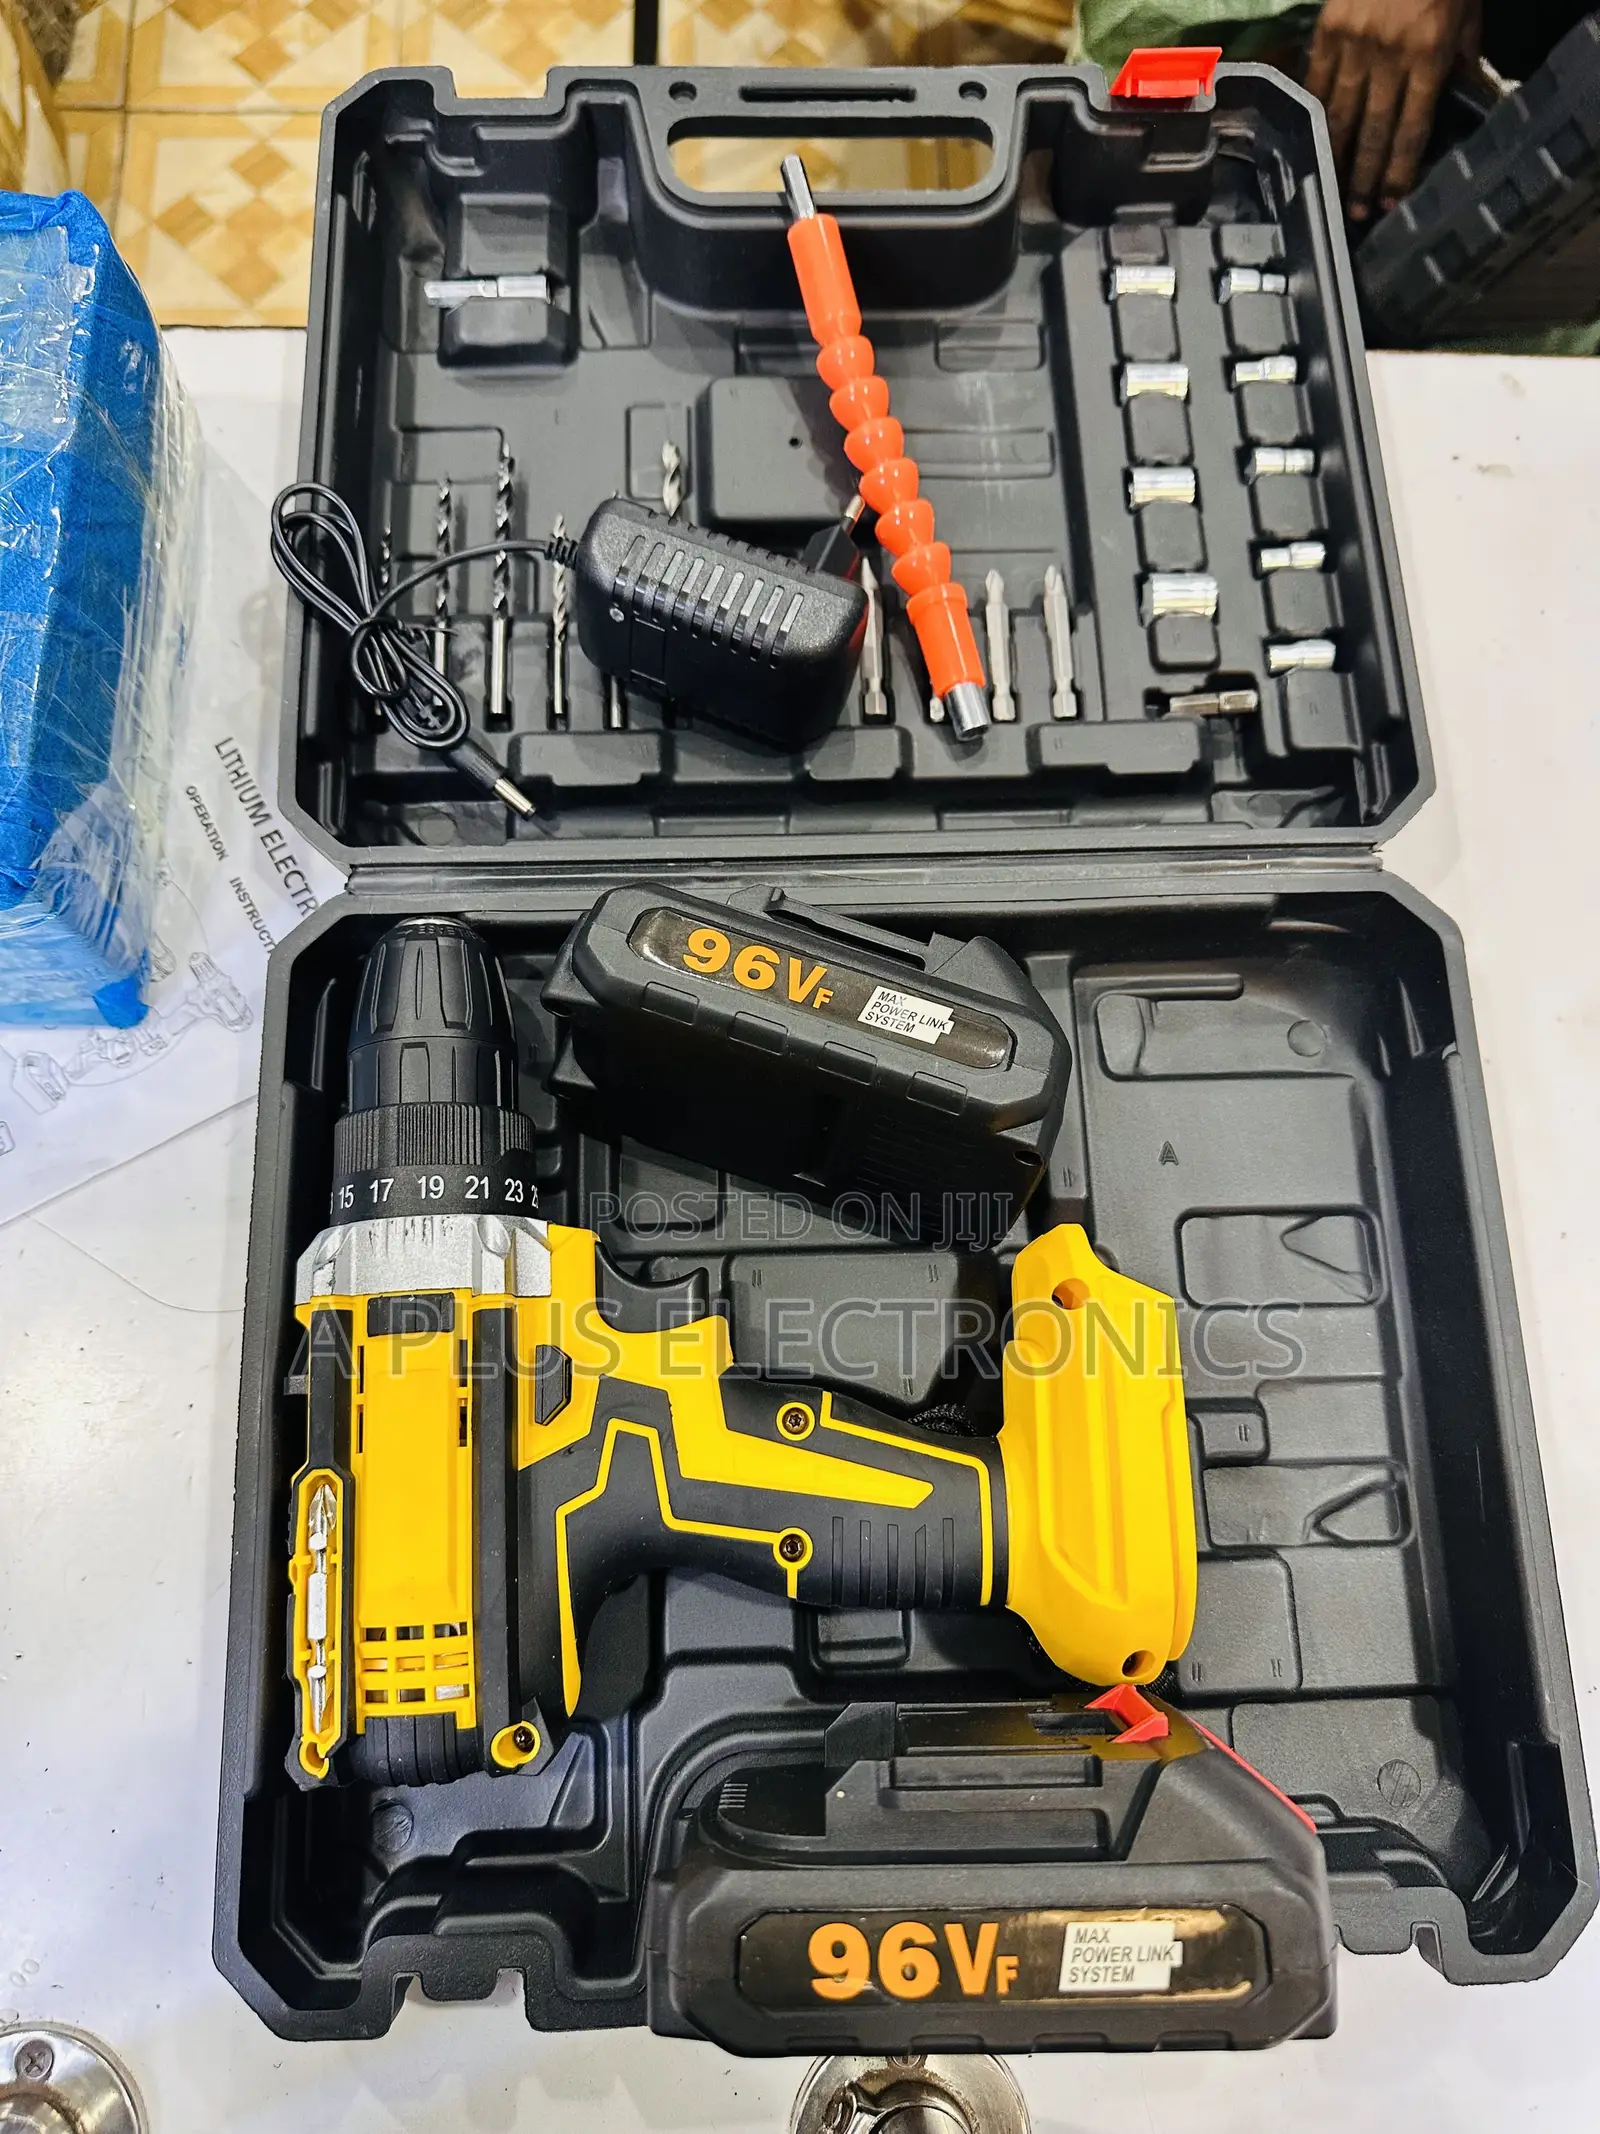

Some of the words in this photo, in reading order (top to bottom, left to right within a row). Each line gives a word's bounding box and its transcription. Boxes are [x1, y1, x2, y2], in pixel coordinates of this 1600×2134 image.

[214, 736, 273, 828] LITHIUM
[185, 785, 229, 862] OPERATION
[877, 990, 908, 1008] MAX
[864, 1011, 916, 1034] SYSTEM
[870, 1001, 918, 1022] POWER
[918, 1013, 950, 1032] LINK
[1158, 1140, 1179, 1166] A
[337, 1184, 355, 1210] 15
[369, 1177, 395, 1204] 17
[417, 1174, 446, 1200] 19
[464, 1175, 490, 1200] 21
[504, 1178, 524, 1203] 23
[1074, 1927, 1110, 1943] MAX
[1071, 1946, 1132, 1963] POWER
[1137, 1945, 1176, 1962] LINK
[1067, 1965, 1135, 1983] SYSTEM
